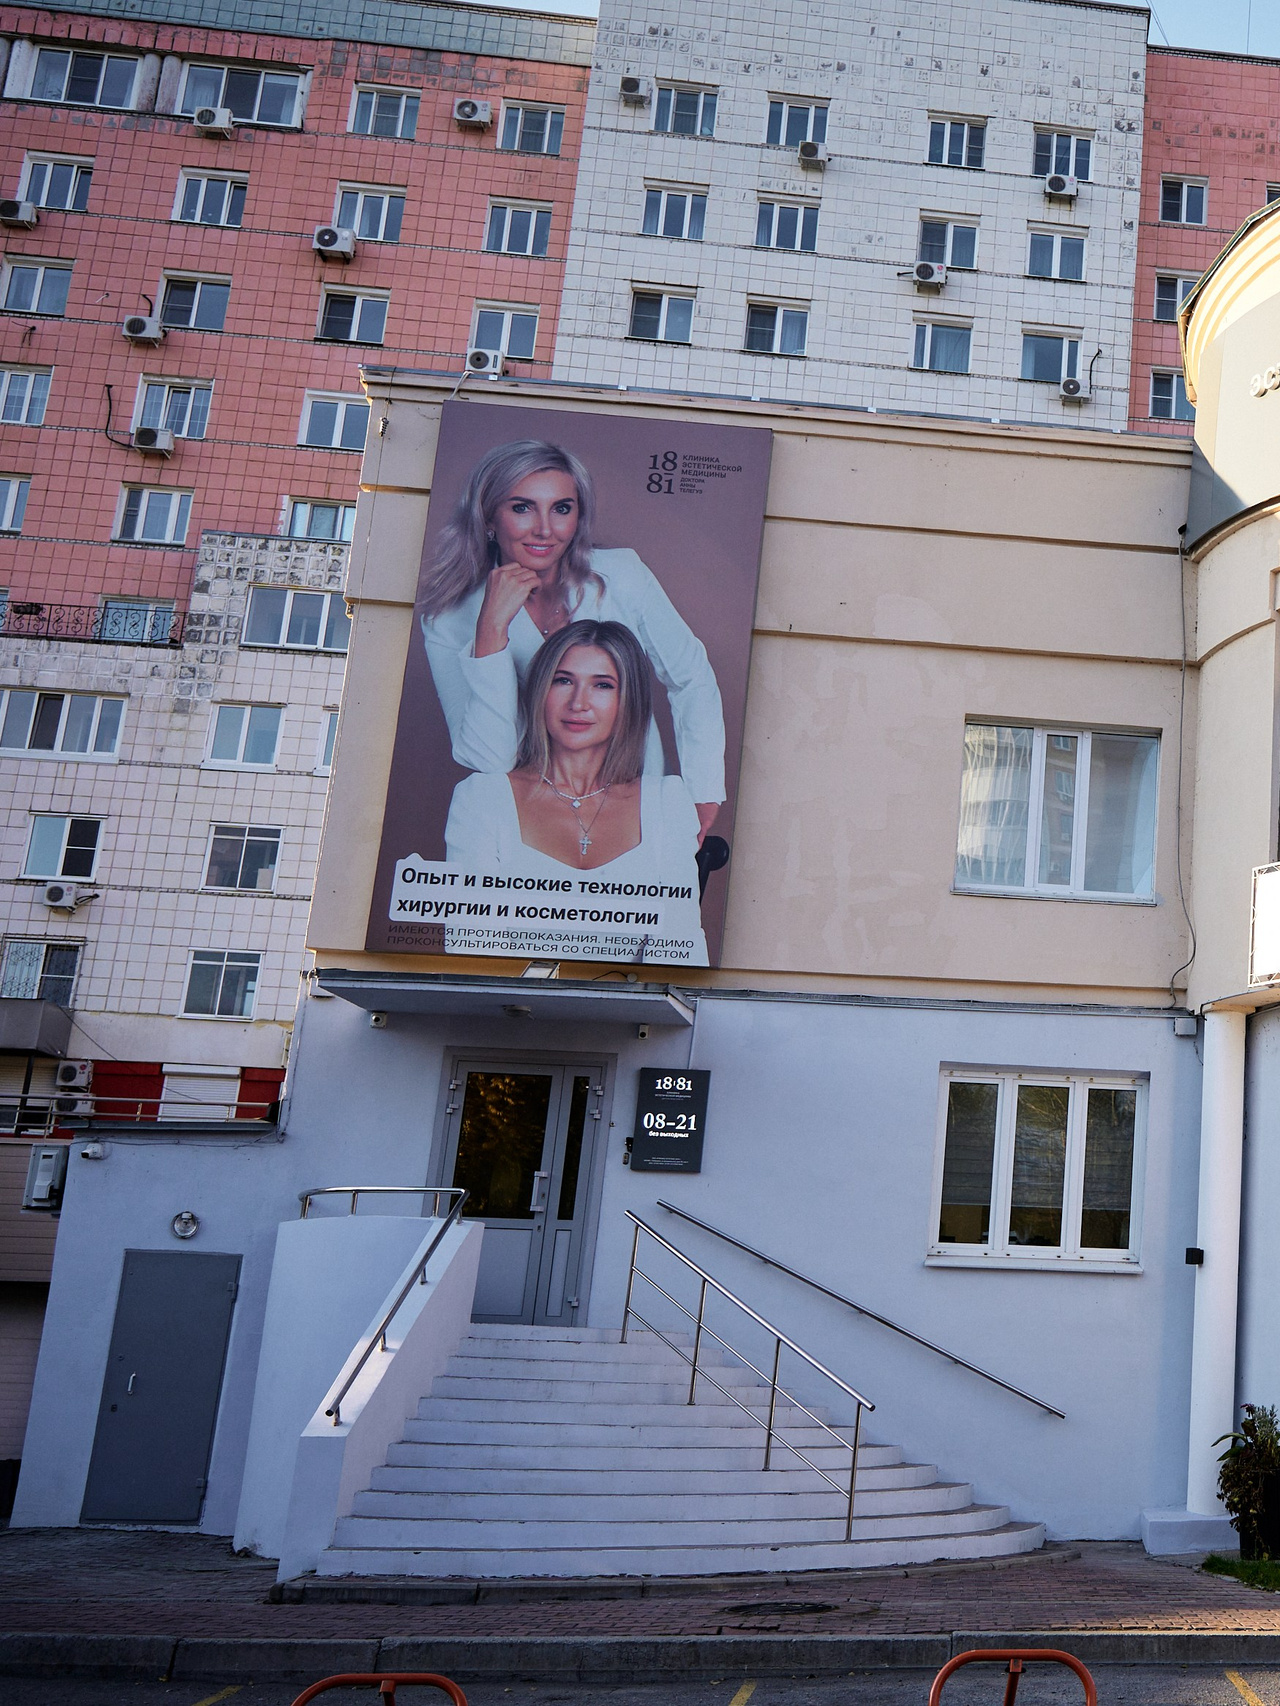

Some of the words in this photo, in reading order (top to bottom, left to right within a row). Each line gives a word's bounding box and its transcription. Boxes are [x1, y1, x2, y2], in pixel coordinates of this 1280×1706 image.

[648, 451, 678, 472] 18
[682, 454, 720, 463] КЛИНИКА
[682, 462, 742, 473] ЭСТЕТИЧЕСКОЙ
[646, 473, 674, 494] 81
[681, 469, 727, 479] МЕДИЦИНЫ
[401, 867, 459, 887] Опыт
[463, 874, 476, 887] и
[482, 875, 573, 892] высокие
[578, 880, 693, 899] технологии
[396, 898, 491, 919] хирургии
[497, 904, 509, 918] и
[515, 905, 659, 926] косметологии
[388, 924, 454, 937] ИМЕЮТСЯ
[457, 927, 601, 945] ПРОТИВОПОКАЗАНИЯ.
[604, 934, 695, 949] НЕОБХОДИМО
[386, 935, 559, 953] ПРОКОНСУЛЬТИРОВАТЬСЯ
[561, 943, 579, 954] СО
[582, 945, 691, 960] СПЕЦИАЛИСТОМ
